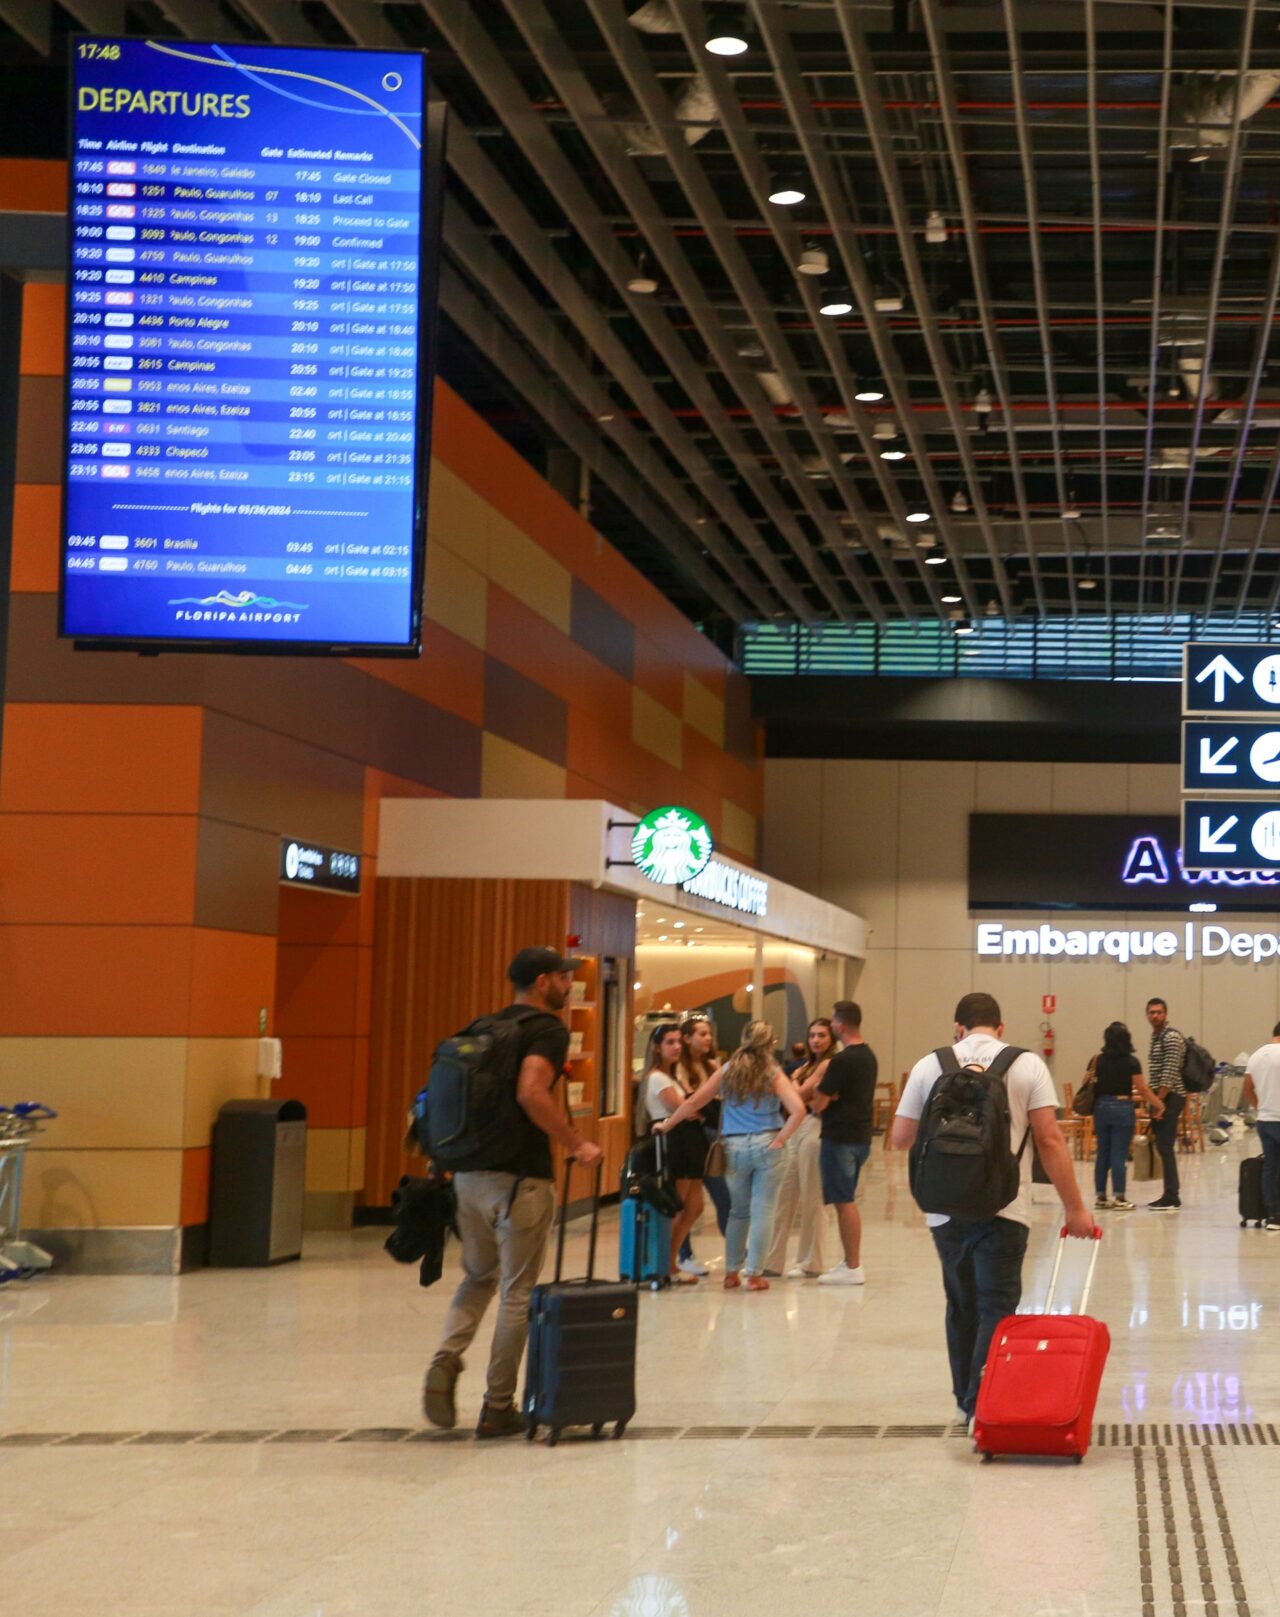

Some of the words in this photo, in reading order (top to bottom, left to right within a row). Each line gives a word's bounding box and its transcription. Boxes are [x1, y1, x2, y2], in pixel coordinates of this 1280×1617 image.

[78, 43, 121, 61] 17:48
[78, 87, 251, 119] DEPARTURES
[78, 138, 102, 150] Time
[106, 140, 137, 152] Airline
[141, 141, 168, 154] Flight
[173, 143, 225, 155] Destination
[261, 147, 283, 158] Gate
[287, 149, 332, 160] Estimated
[334, 150, 373, 161] Remarks
[333, 173, 357, 183] Gate
[358, 173, 391, 184] Closed
[174, 187, 204, 200] Paulo,
[204, 188, 254, 200] Guarulhos
[333, 194, 353, 204] Last
[354, 195, 373, 205] Call
[199, 210, 254, 223] Congonhas
[333, 216, 372, 226] Proceed
[374, 218, 385, 227] to
[386, 218, 410, 228] Gate
[199, 231, 254, 244] Congonhas
[332, 237, 384, 248] Confirmed
[204, 252, 254, 264] Guarulhos
[352, 259, 376, 269] Gate
[169, 273, 218, 286] Campinas
[352, 281, 375, 291] Gate
[197, 297, 252, 310] Congonhas
[351, 302, 375, 312] Gate
[169, 316, 196, 327] Porto
[197, 318, 230, 330] Alegre
[351, 323, 375, 334] Gate
[196, 339, 252, 352] Congonhas
[351, 345, 374, 355] Gate
[168, 360, 216, 372] Campinas
[350, 366, 374, 377] Gate
[191, 383, 219, 395] Aires,
[221, 384, 251, 394] Ezeiza
[349, 389, 373, 399] Gate
[191, 404, 218, 417] Aires,
[220, 405, 250, 416] Ezeiza
[349, 409, 373, 420] Gate
[166, 424, 209, 437] Santiago
[349, 431, 372, 441] Gate
[166, 446, 209, 459] Chapecó
[348, 452, 372, 463] Gate
[190, 469, 217, 482] Aires,
[218, 470, 248, 480] Ezeiza
[348, 474, 372, 484] Gate
[190, 503, 221, 516] Flights
[222, 503, 237, 514] for
[346, 544, 370, 554] Gate
[197, 562, 247, 573] Guarulhos
[346, 566, 369, 576] Gate
[175, 610, 236, 622] FLORIPA
[238, 612, 301, 623] AIRPORT
[1123, 837, 1168, 883] A
[976, 923, 1179, 963] Embarque
